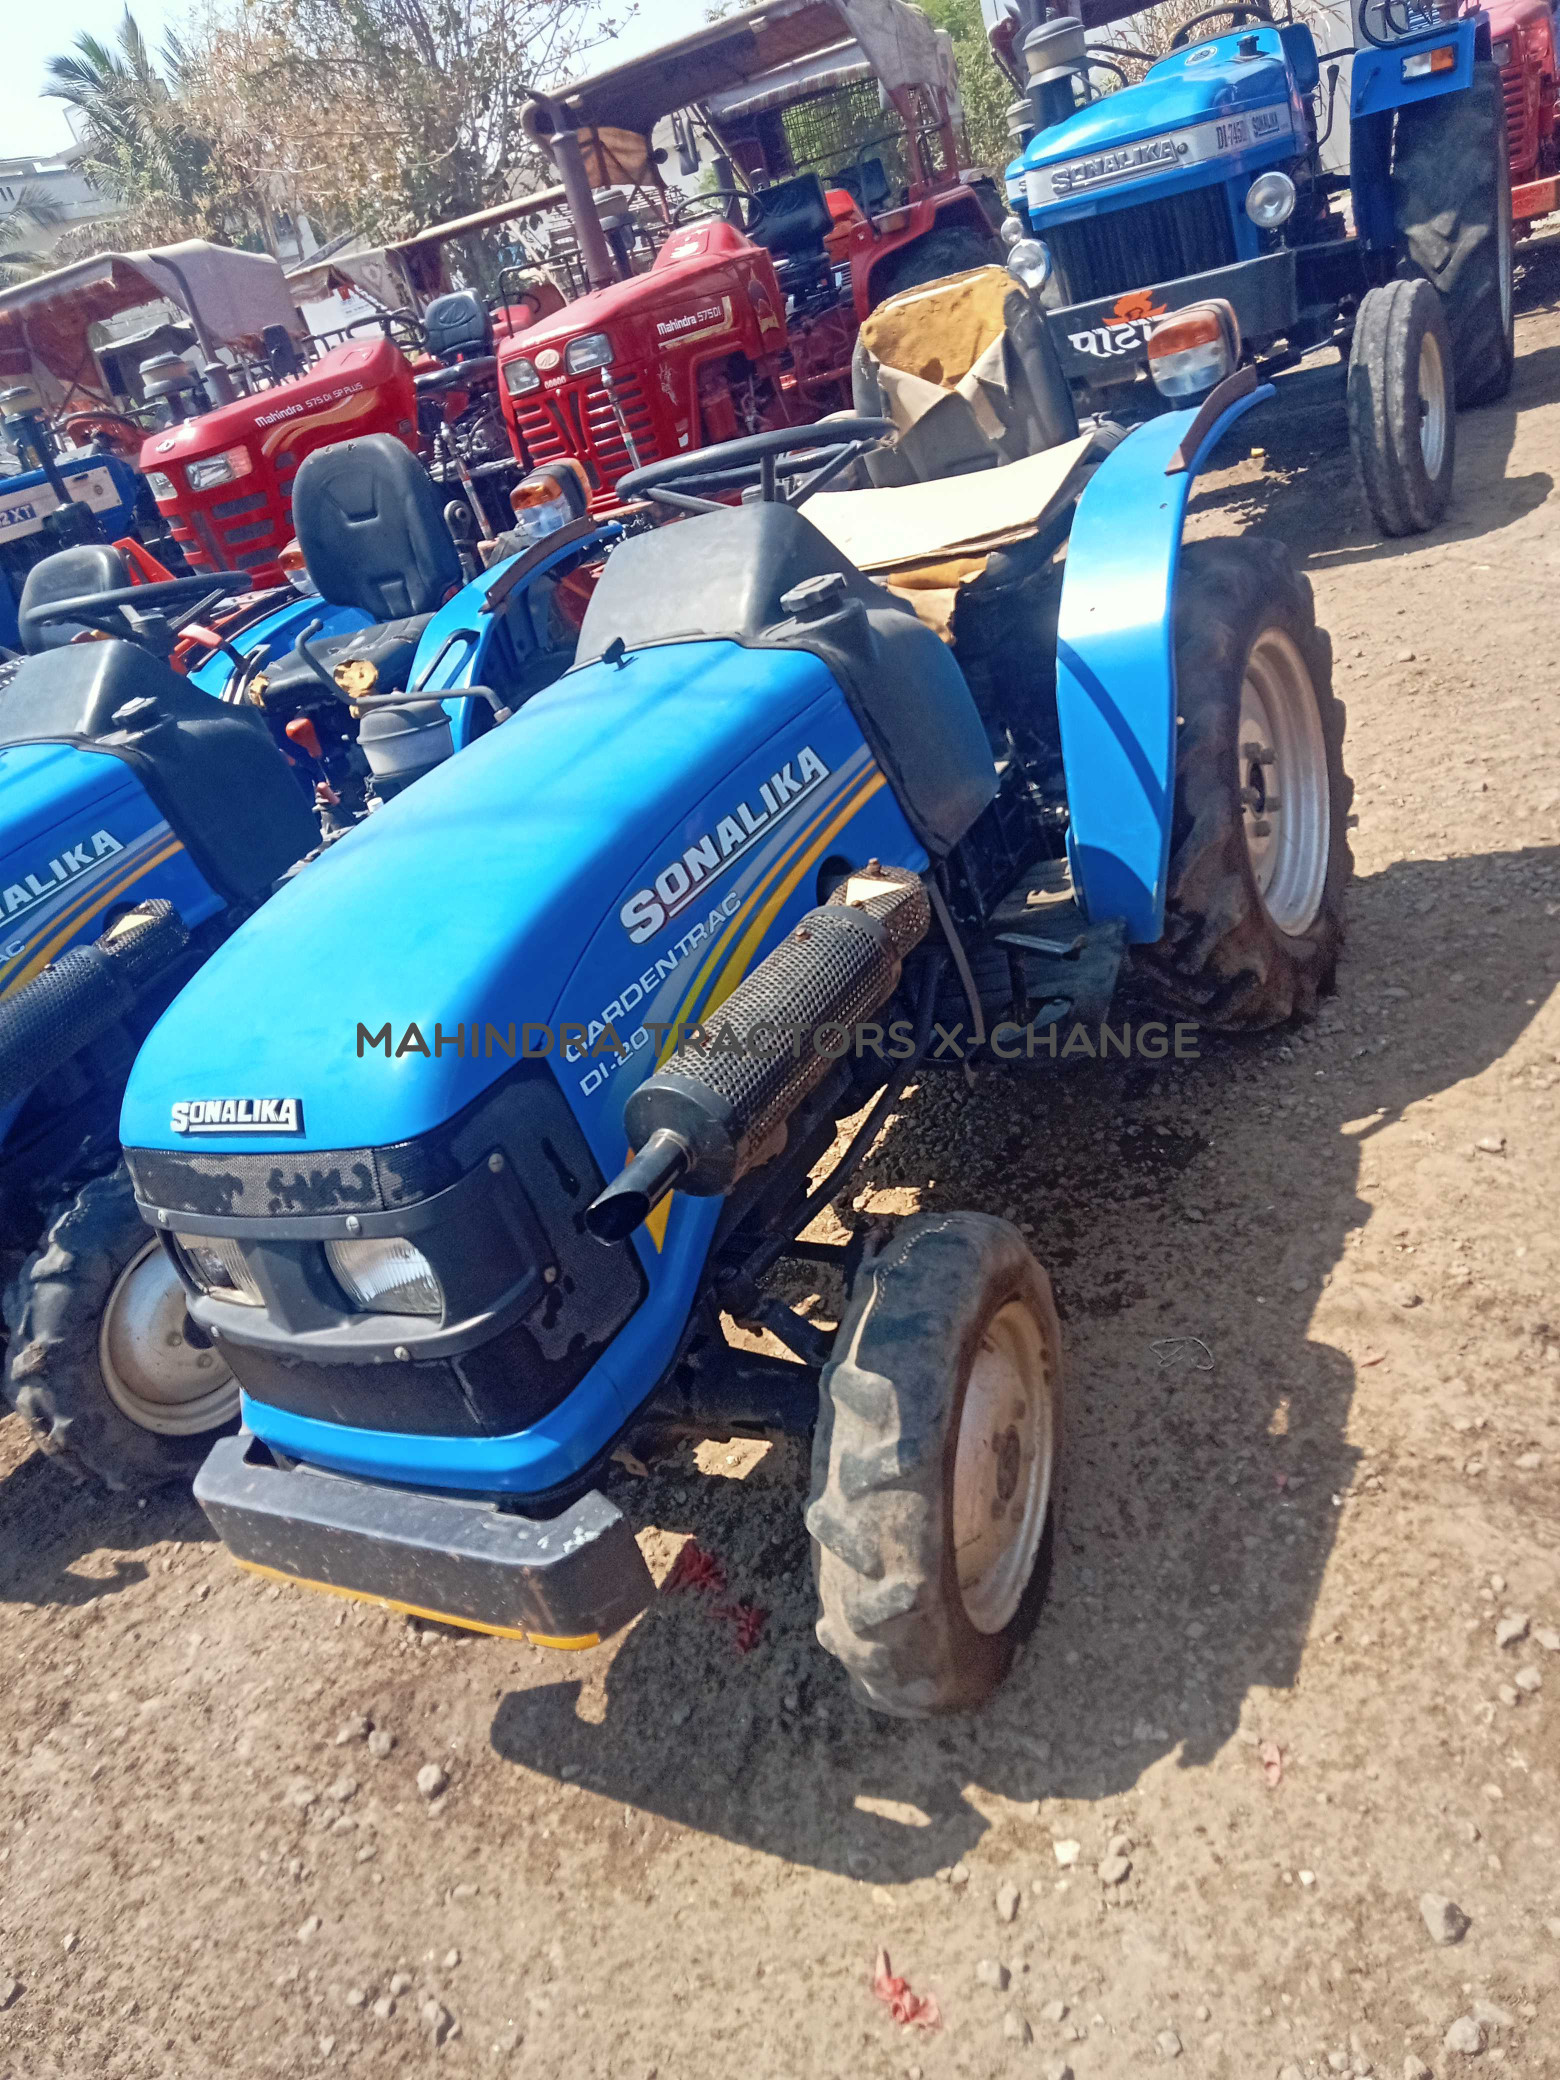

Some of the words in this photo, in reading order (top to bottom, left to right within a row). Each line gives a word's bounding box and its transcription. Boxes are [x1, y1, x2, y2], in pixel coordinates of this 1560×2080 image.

[1050, 138, 1178, 194] SONALIKA
[656, 315, 697, 335] Mahindra
[254, 403, 304, 428] Mahindra
[620, 745, 831, 945] SONALIKA
[0, 829, 125, 925] ALIKA
[169, 1098, 298, 1133] SONALIKA
